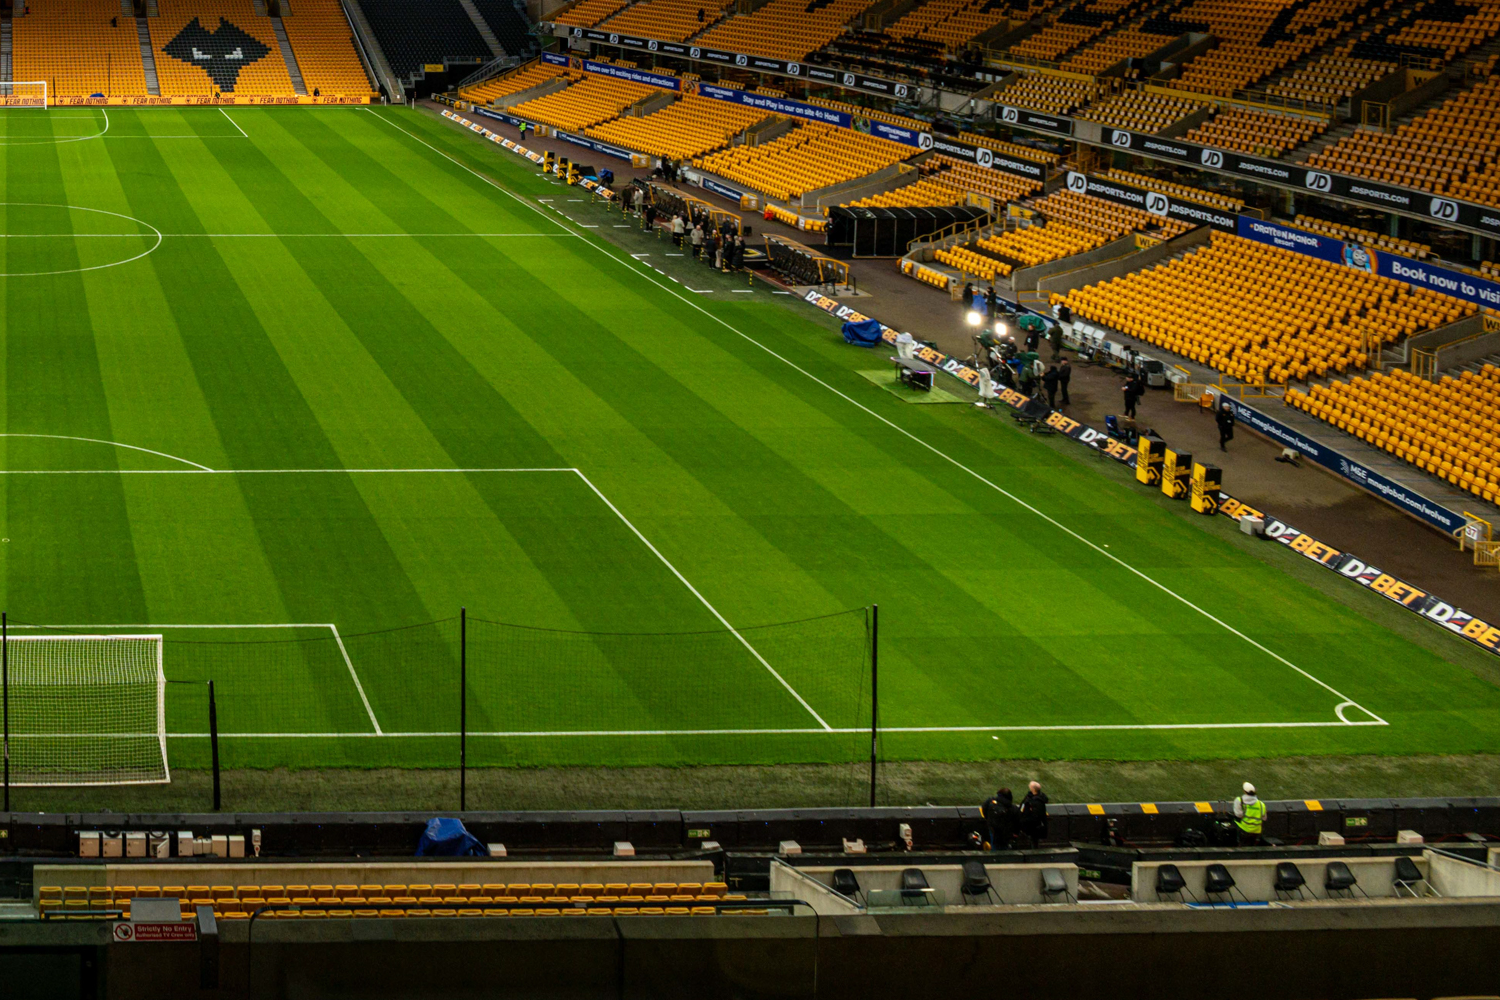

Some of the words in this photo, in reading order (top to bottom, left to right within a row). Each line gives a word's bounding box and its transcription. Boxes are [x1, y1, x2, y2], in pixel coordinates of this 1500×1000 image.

[586, 63, 600, 73] Explore
[616, 69, 631, 80] exciting
[632, 72, 642, 81] rides
[651, 76, 674, 88] attractions
[743, 94, 754, 105] Stay
[755, 98, 765, 107] and
[766, 99, 778, 110] Play
[804, 108, 814, 117] site
[824, 112, 840, 123] Hotel
[933, 141, 975, 158] JDSPORTS.COM
[1144, 141, 1187, 156] JDSPORTS.COM
[993, 157, 1040, 175] JDSPORTS.COM
[1238, 162, 1289, 178] JDSPORTS.COM
[1088, 183, 1143, 204] JDSPORTS.COM
[1350, 186, 1409, 205] JDSPORTS.COM
[1170, 205, 1234, 228] JDSPORTS.COM
[1274, 237, 1295, 248] Resort
[1392, 262, 1427, 283] Book
[1429, 274, 1458, 291] now
[1460, 281, 1476, 296] to
[1479, 289, 1500, 305] visi
[1046, 411, 1081, 433] BET
[1350, 464, 1367, 480] M&E
[1367, 476, 1451, 526] mneglobal.com/wolves
[1220, 493, 1264, 521] BET
[1265, 520, 1341, 565] DEBET
[1466, 526, 1478, 538] 37
[1339, 558, 1426, 607] DEBET
[1427, 601, 1500, 648] DEBE
[137, 925, 160, 933] Strictly
[174, 926, 192, 934] Entry
